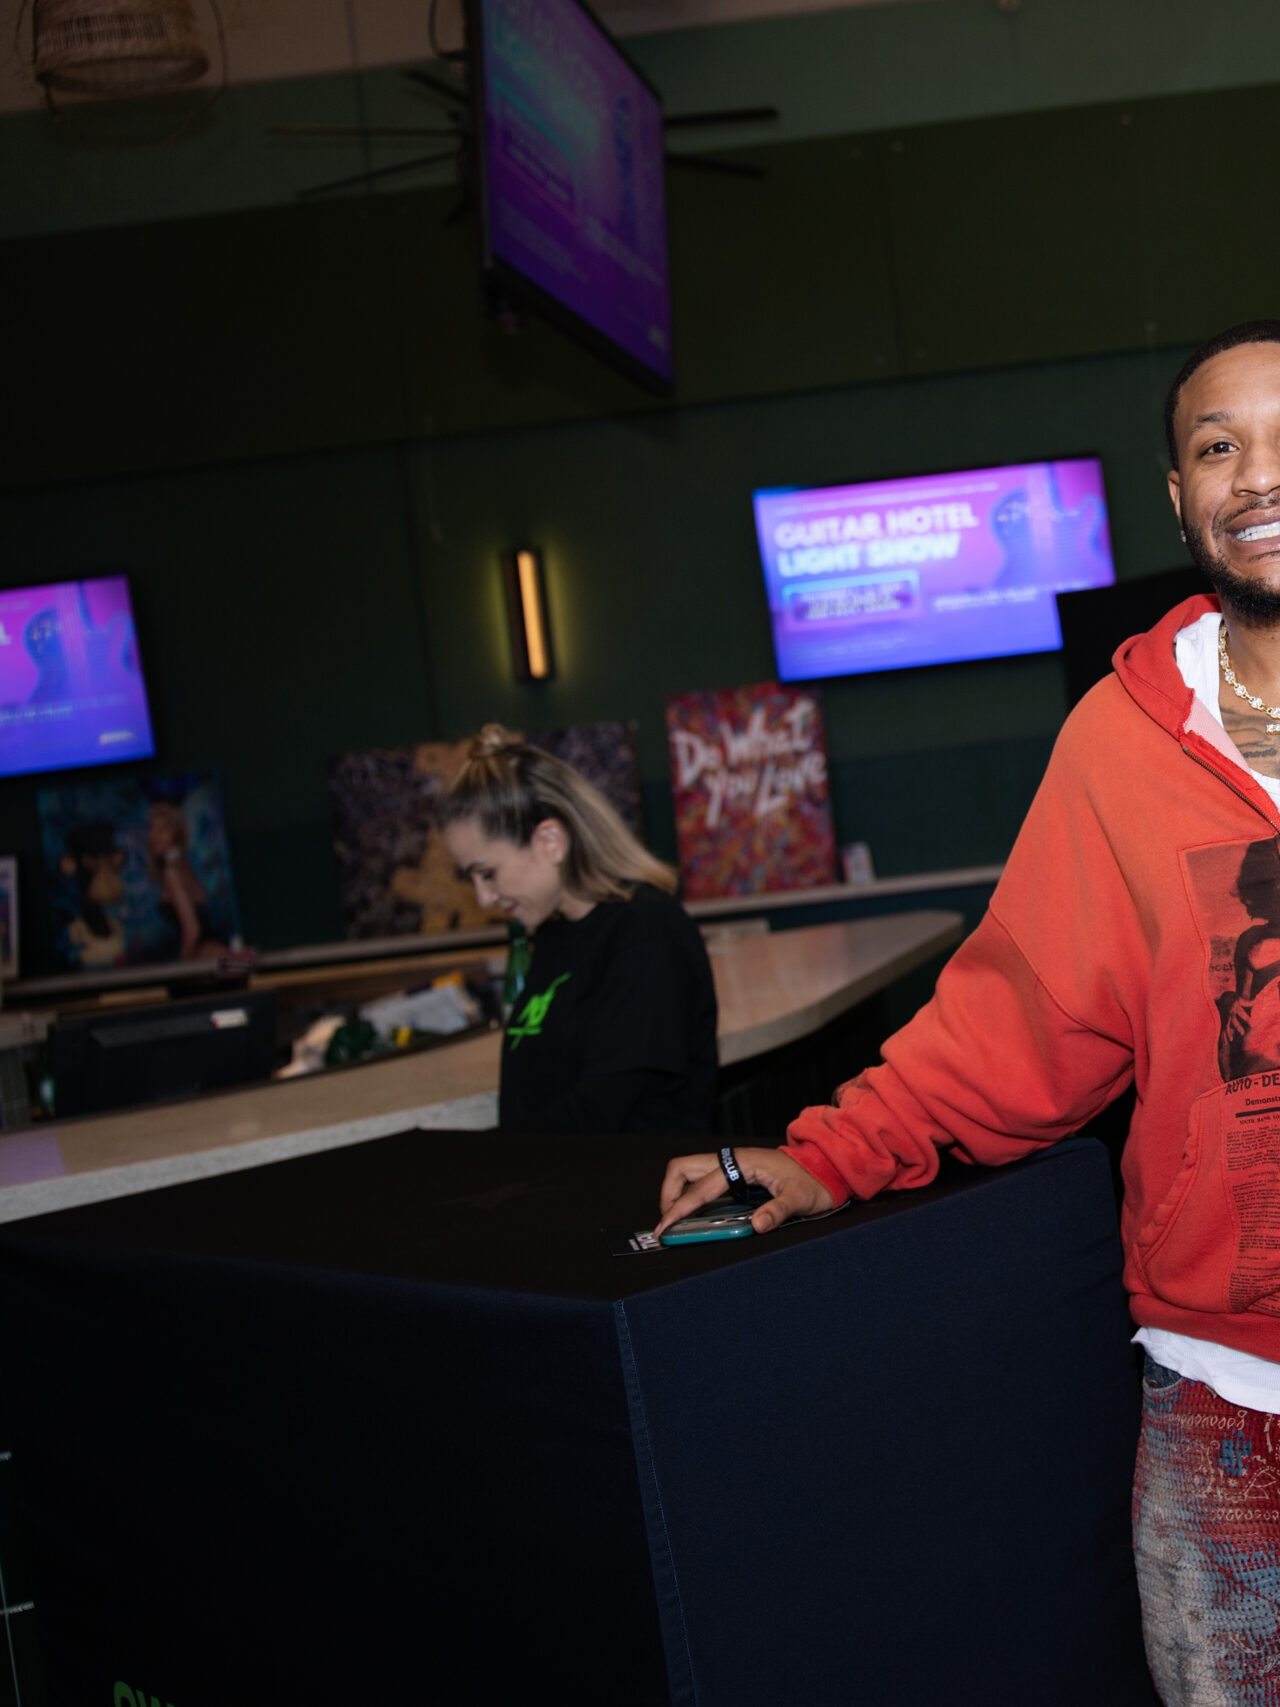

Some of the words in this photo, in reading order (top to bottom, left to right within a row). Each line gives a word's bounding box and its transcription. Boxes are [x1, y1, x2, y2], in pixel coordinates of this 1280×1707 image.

[774, 512, 882, 547] GUITAR
[886, 502, 980, 535] HOTEL
[777, 544, 860, 577] LIGHT
[866, 531, 961, 568] SHOW
